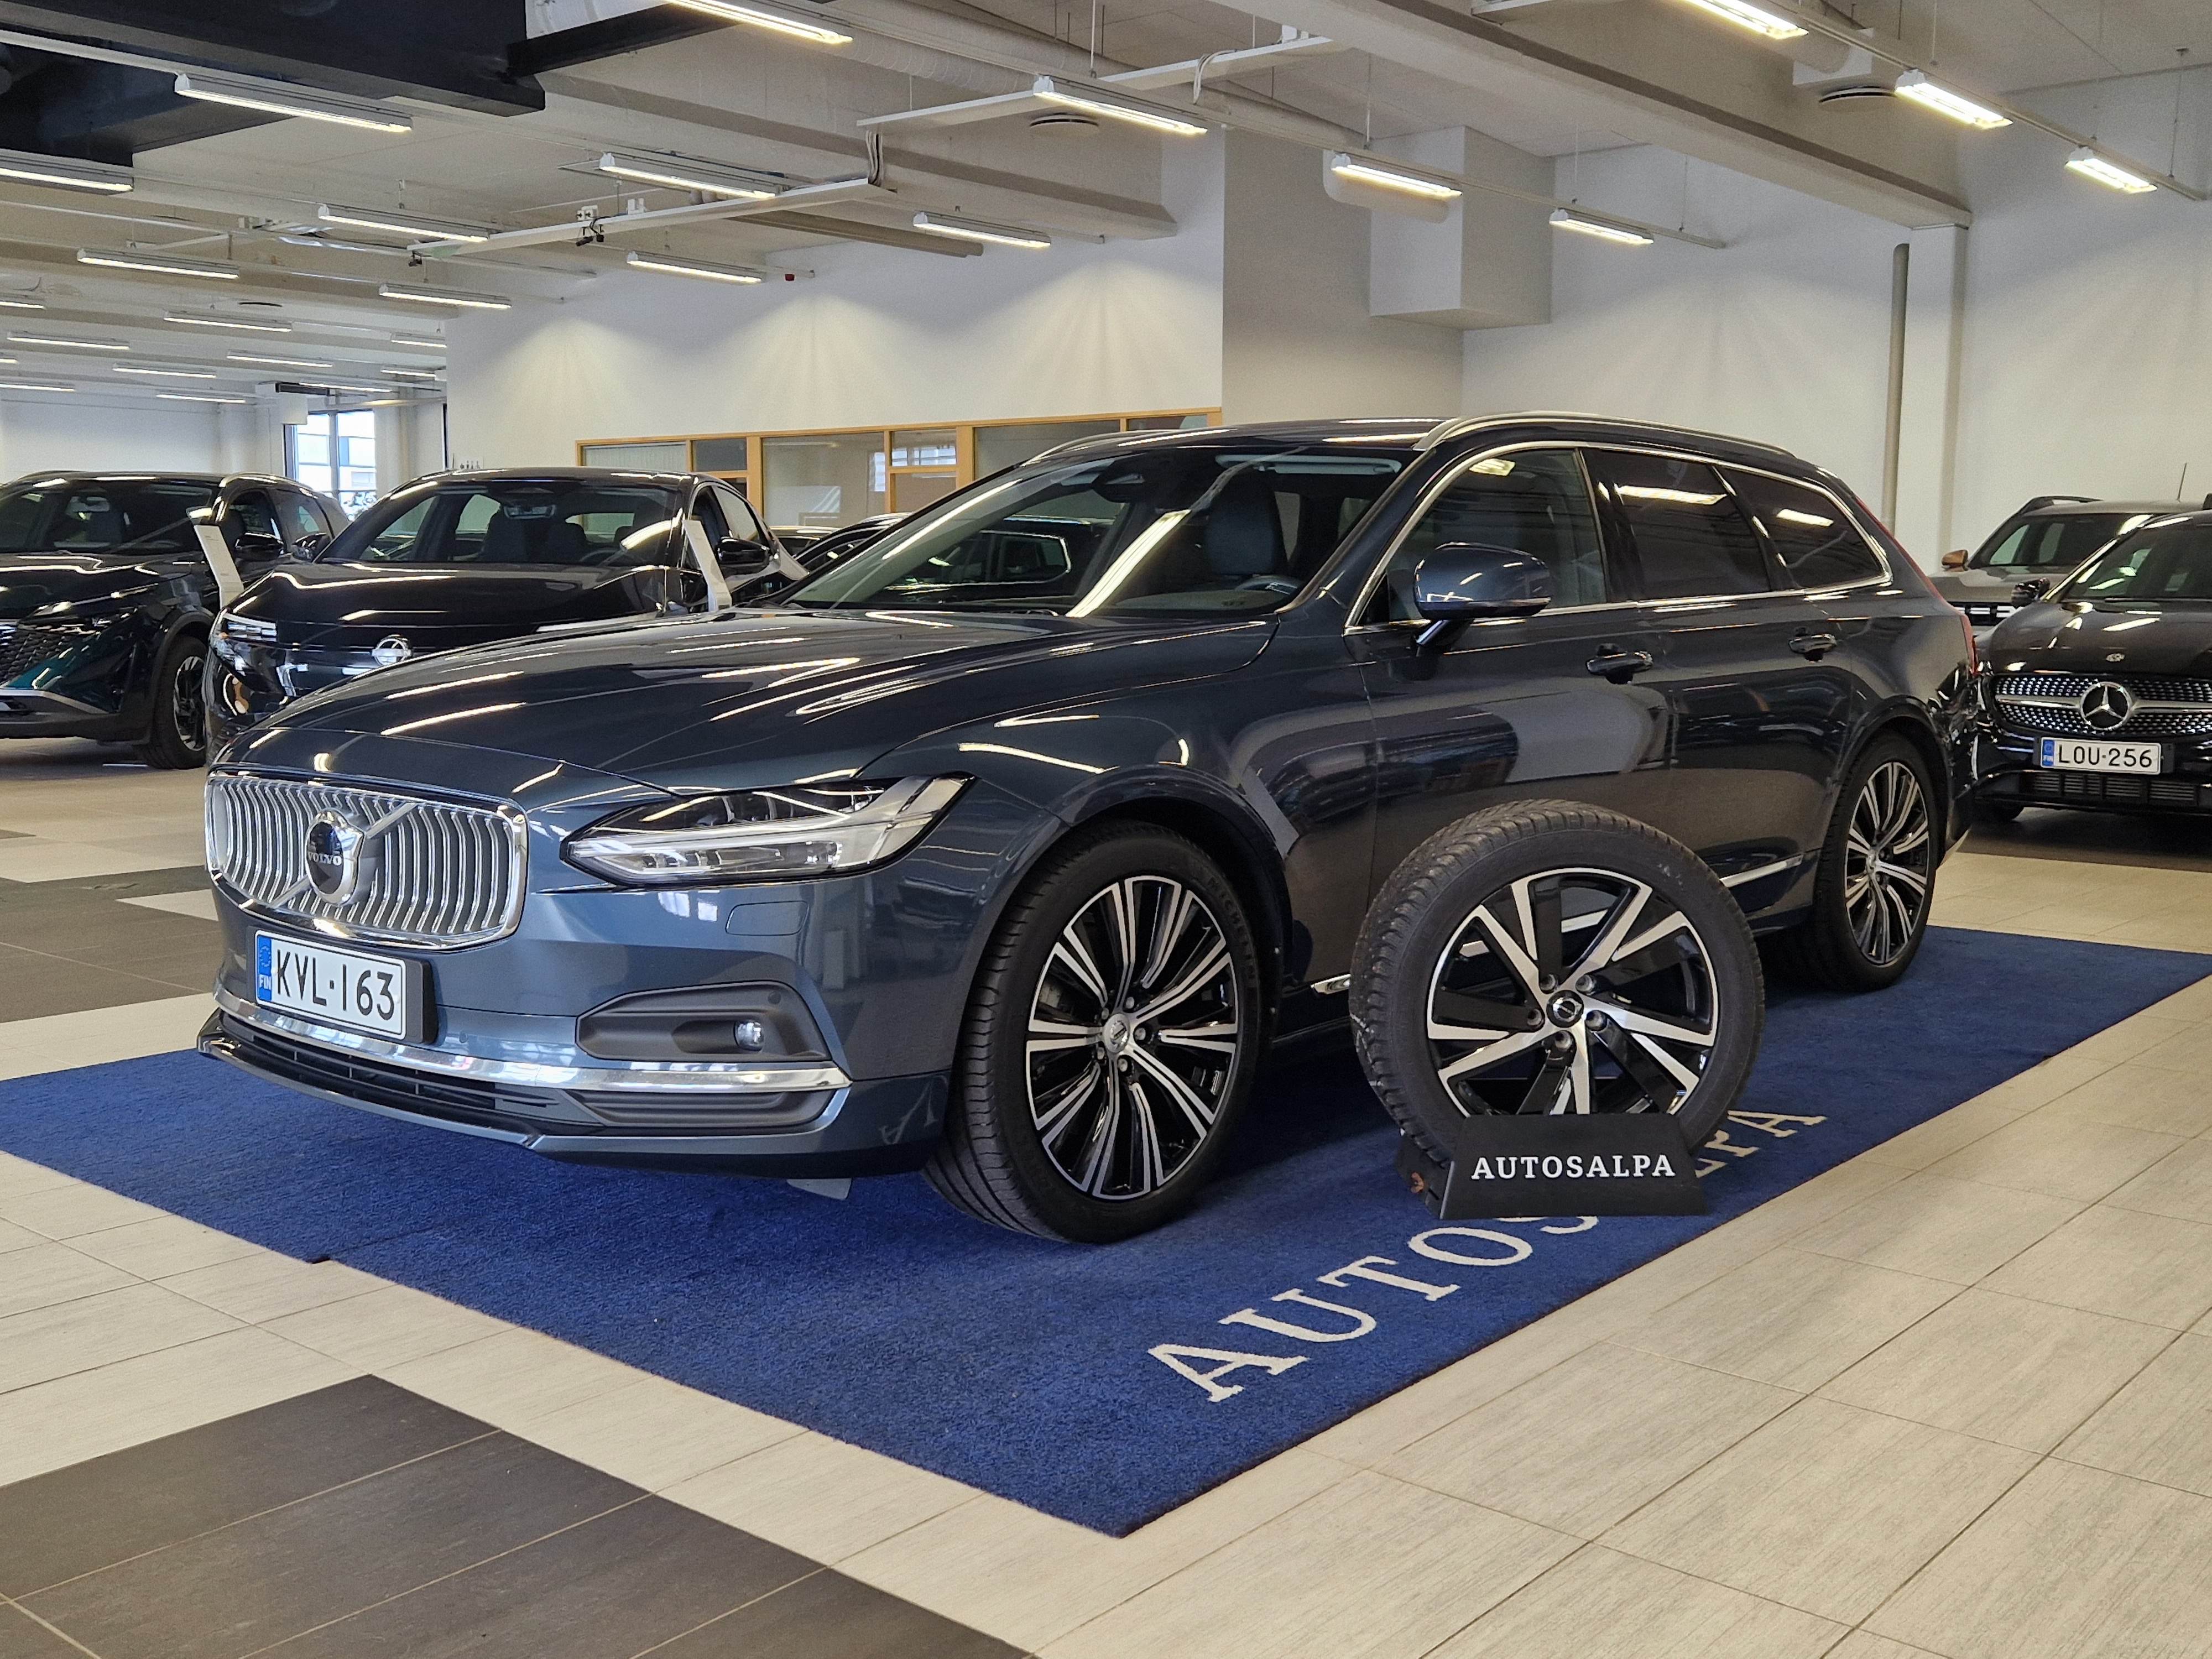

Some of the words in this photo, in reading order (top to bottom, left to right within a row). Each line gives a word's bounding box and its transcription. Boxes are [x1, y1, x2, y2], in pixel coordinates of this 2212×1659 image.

[2058, 744, 2153, 768] LOU-256
[307, 852, 342, 866] VOLVO
[259, 974, 272, 990] FIN
[277, 948, 395, 1021] KVL-163
[1470, 1154, 1676, 1180] AUTOSALPA
